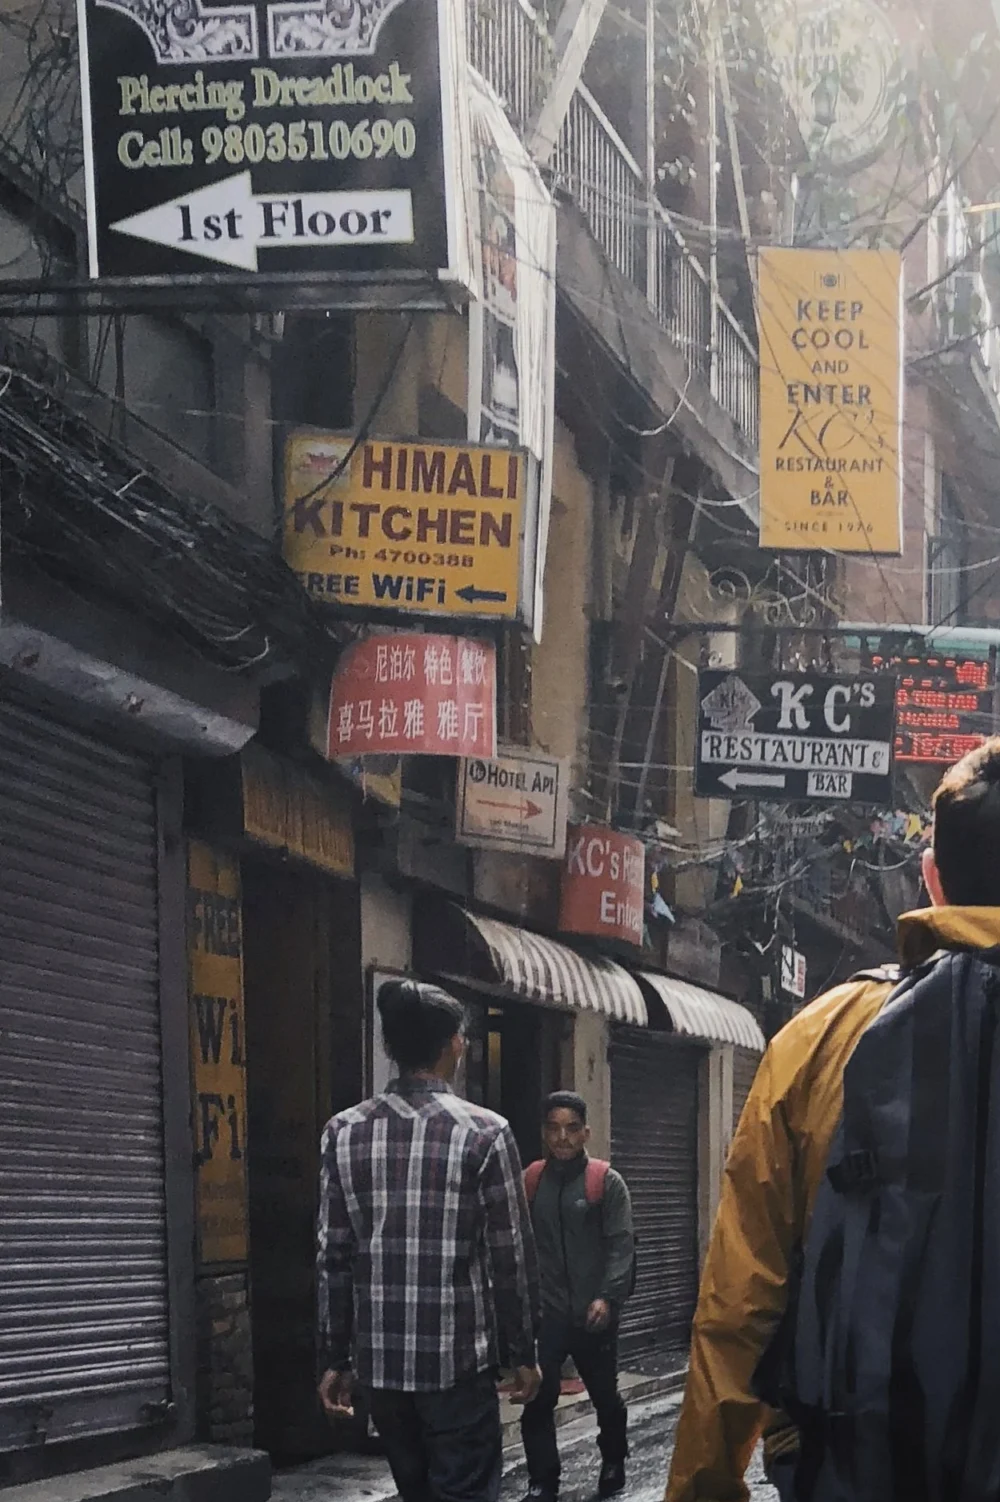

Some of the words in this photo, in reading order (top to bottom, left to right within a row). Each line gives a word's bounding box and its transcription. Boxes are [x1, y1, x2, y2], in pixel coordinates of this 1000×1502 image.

[117, 70, 245, 121] Piercing
[251, 61, 413, 108] Dreadlock
[117, 126, 193, 169] Cell:
[201, 118, 416, 164] 9803510690
[176, 204, 245, 242] 1st
[257, 199, 393, 239] Floor
[797, 299, 864, 322] KEEP
[790, 327, 870, 351] COOL
[811, 359, 849, 375] AND
[787, 383, 872, 406] ENTER
[362, 445, 518, 500] HIMALI
[775, 456, 885, 473] RESTAURANT
[824, 476, 835, 489] &
[810, 489, 850, 507] BAR
[293, 498, 513, 548] KITCHEN
[784, 520, 829, 533] SINCE
[337, 699, 425, 744] 喜马拉雅
[436, 699, 484, 743] 雅厅
[704, 736, 868, 770] RESTAURANT
[811, 772, 850, 794] BAR
[567, 835, 620, 880] KC's
